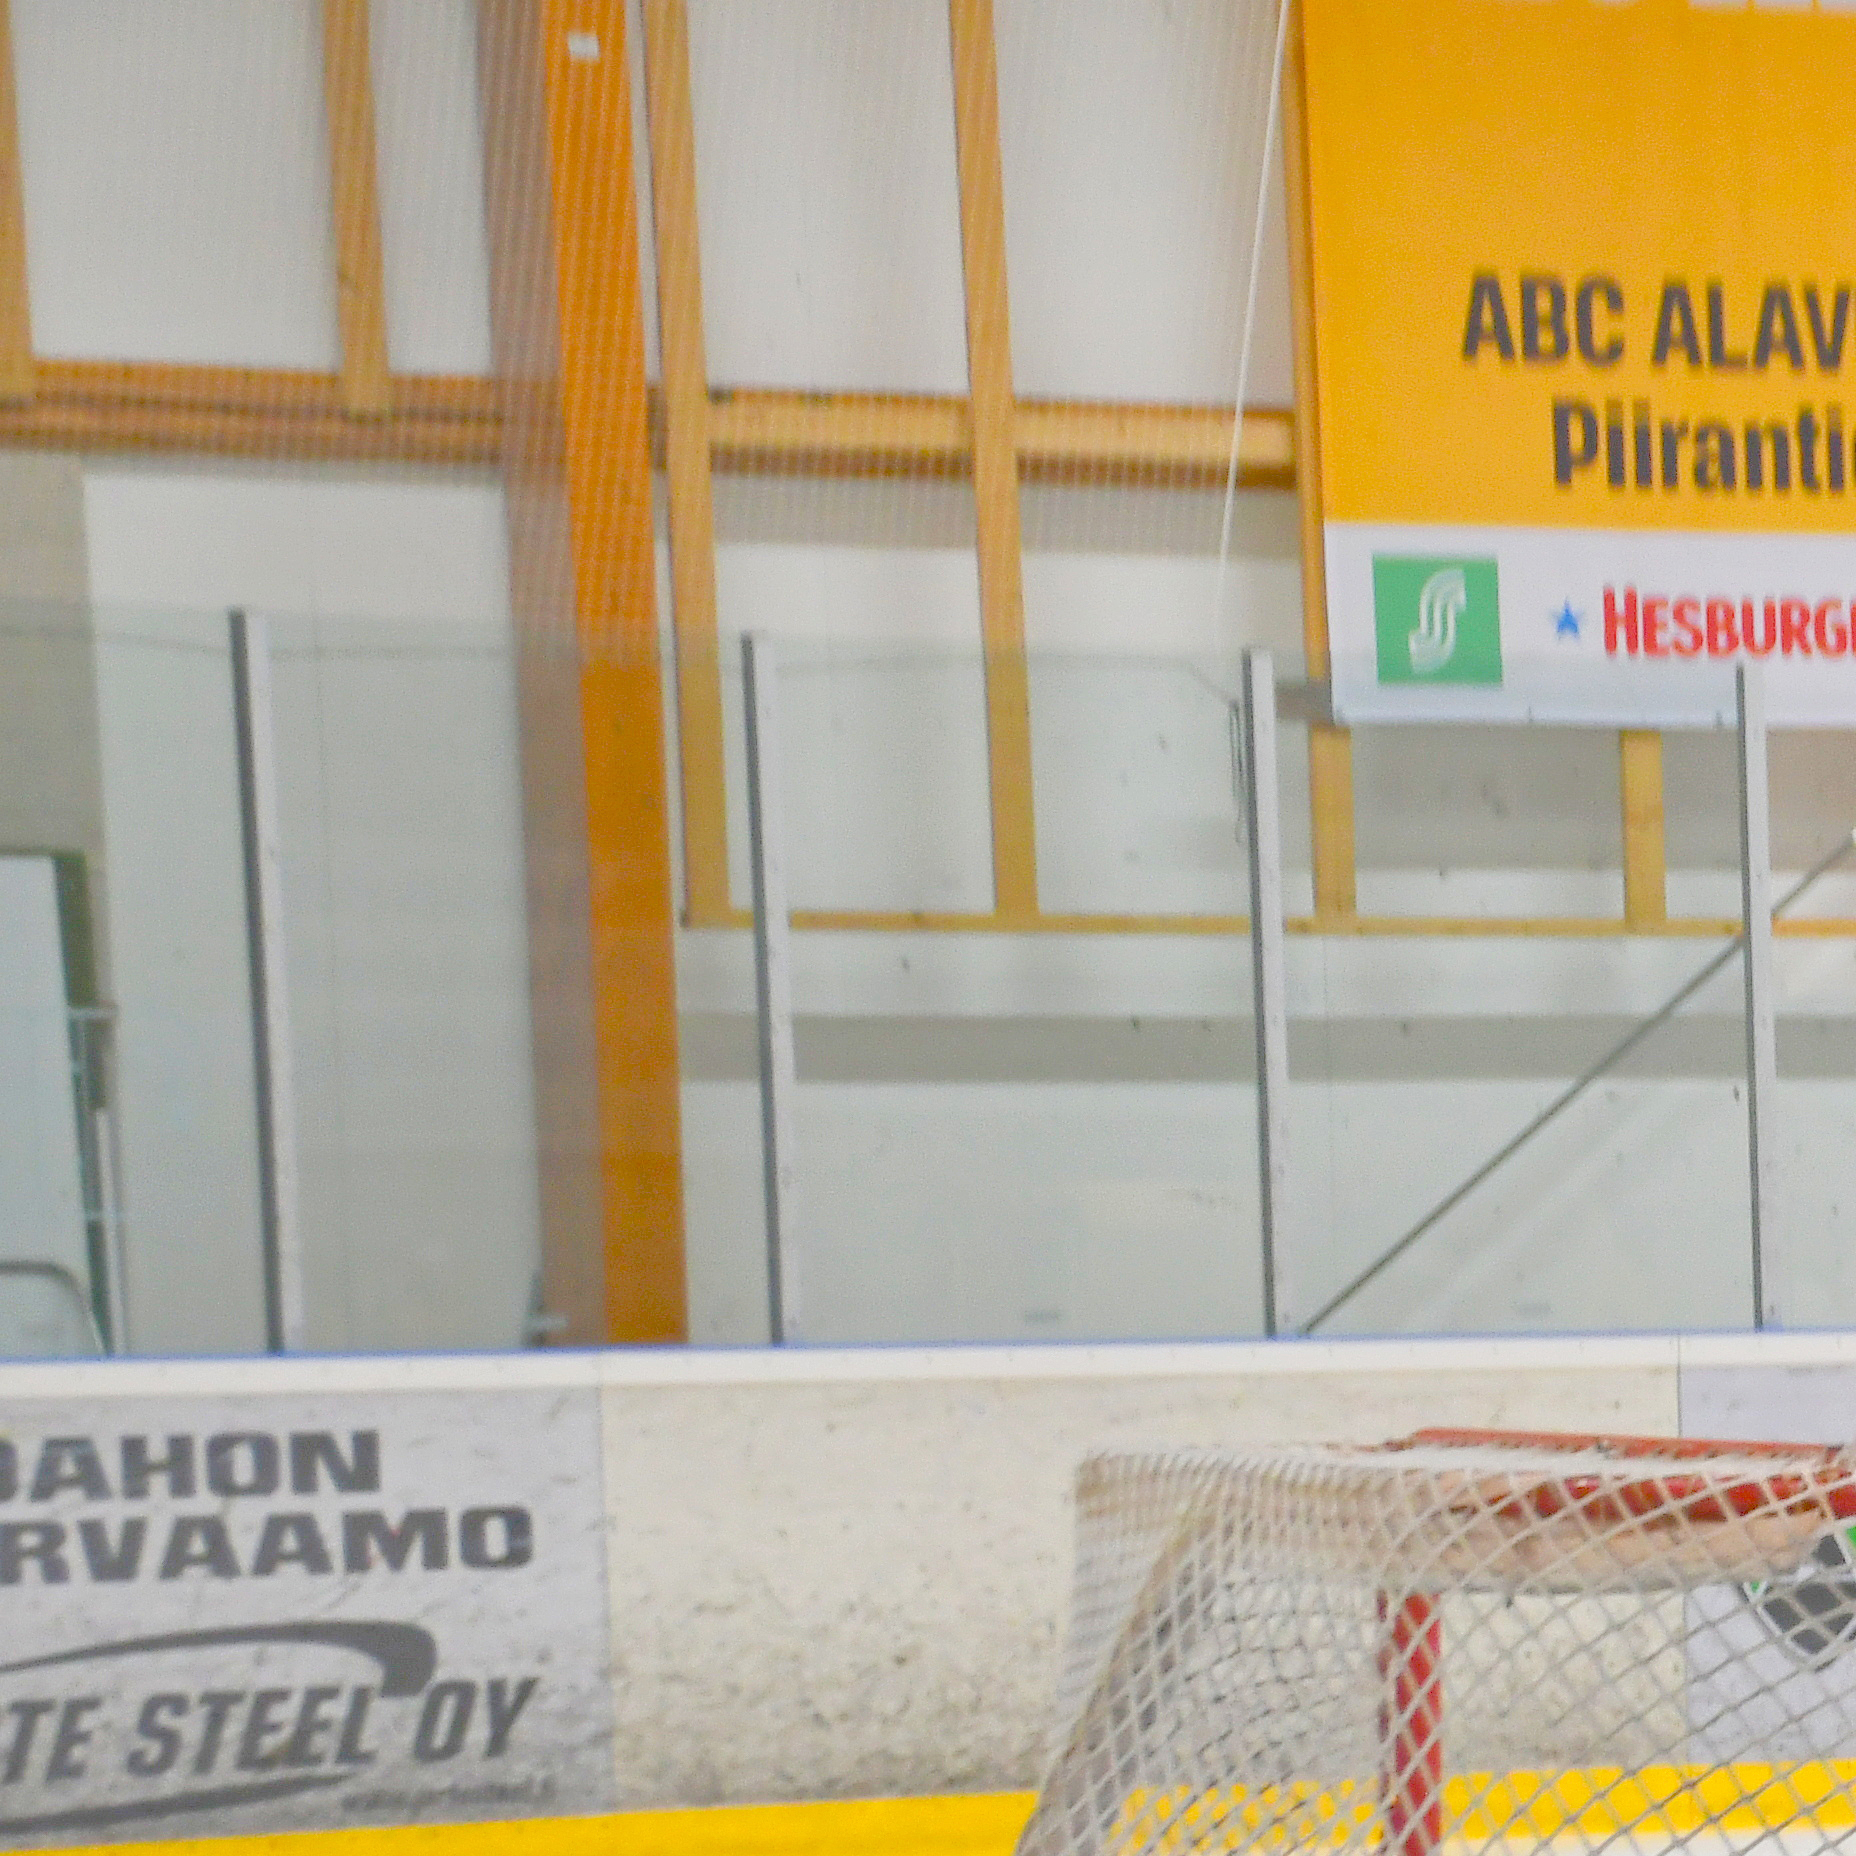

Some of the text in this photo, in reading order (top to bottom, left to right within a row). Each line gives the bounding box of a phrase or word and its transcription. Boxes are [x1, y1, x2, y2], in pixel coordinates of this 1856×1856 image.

[1463, 270, 1626, 368] ABC
[126, 1686, 378, 1778] STEEL
[414, 1677, 541, 1765] OY
